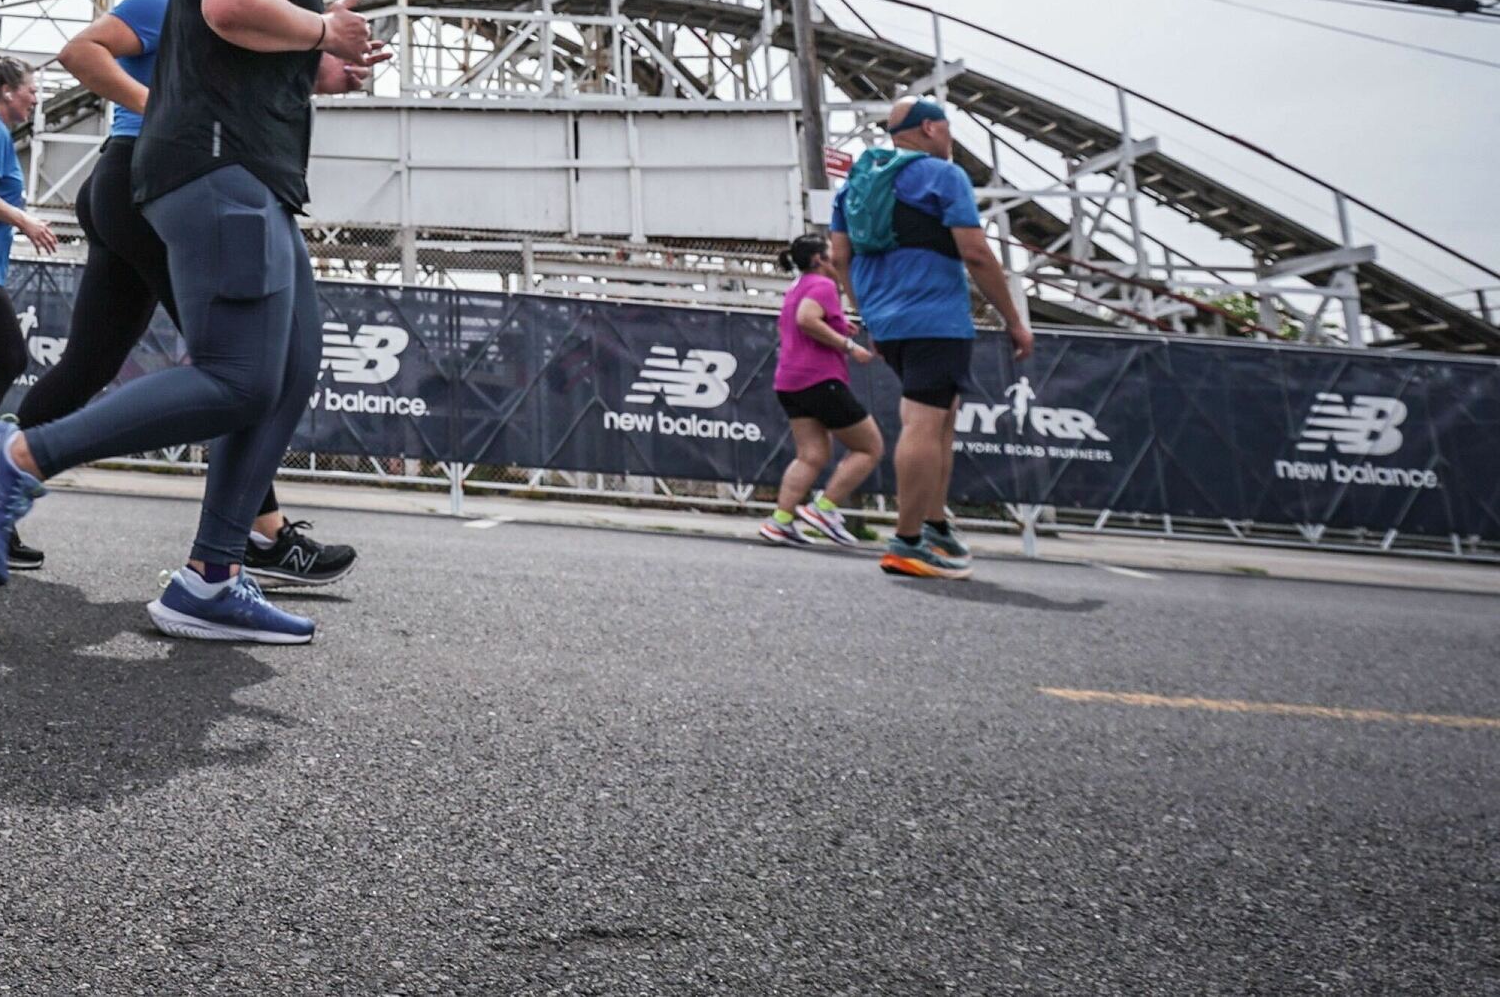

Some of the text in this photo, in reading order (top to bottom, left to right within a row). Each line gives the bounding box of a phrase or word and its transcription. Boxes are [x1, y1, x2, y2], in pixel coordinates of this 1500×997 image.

[603, 410, 654, 433] new
[967, 441, 1002, 454] YORK
[1003, 443, 1046, 458] ROAD
[1049, 445, 1114, 463] RUNNERS
[1274, 459, 1329, 482] new
